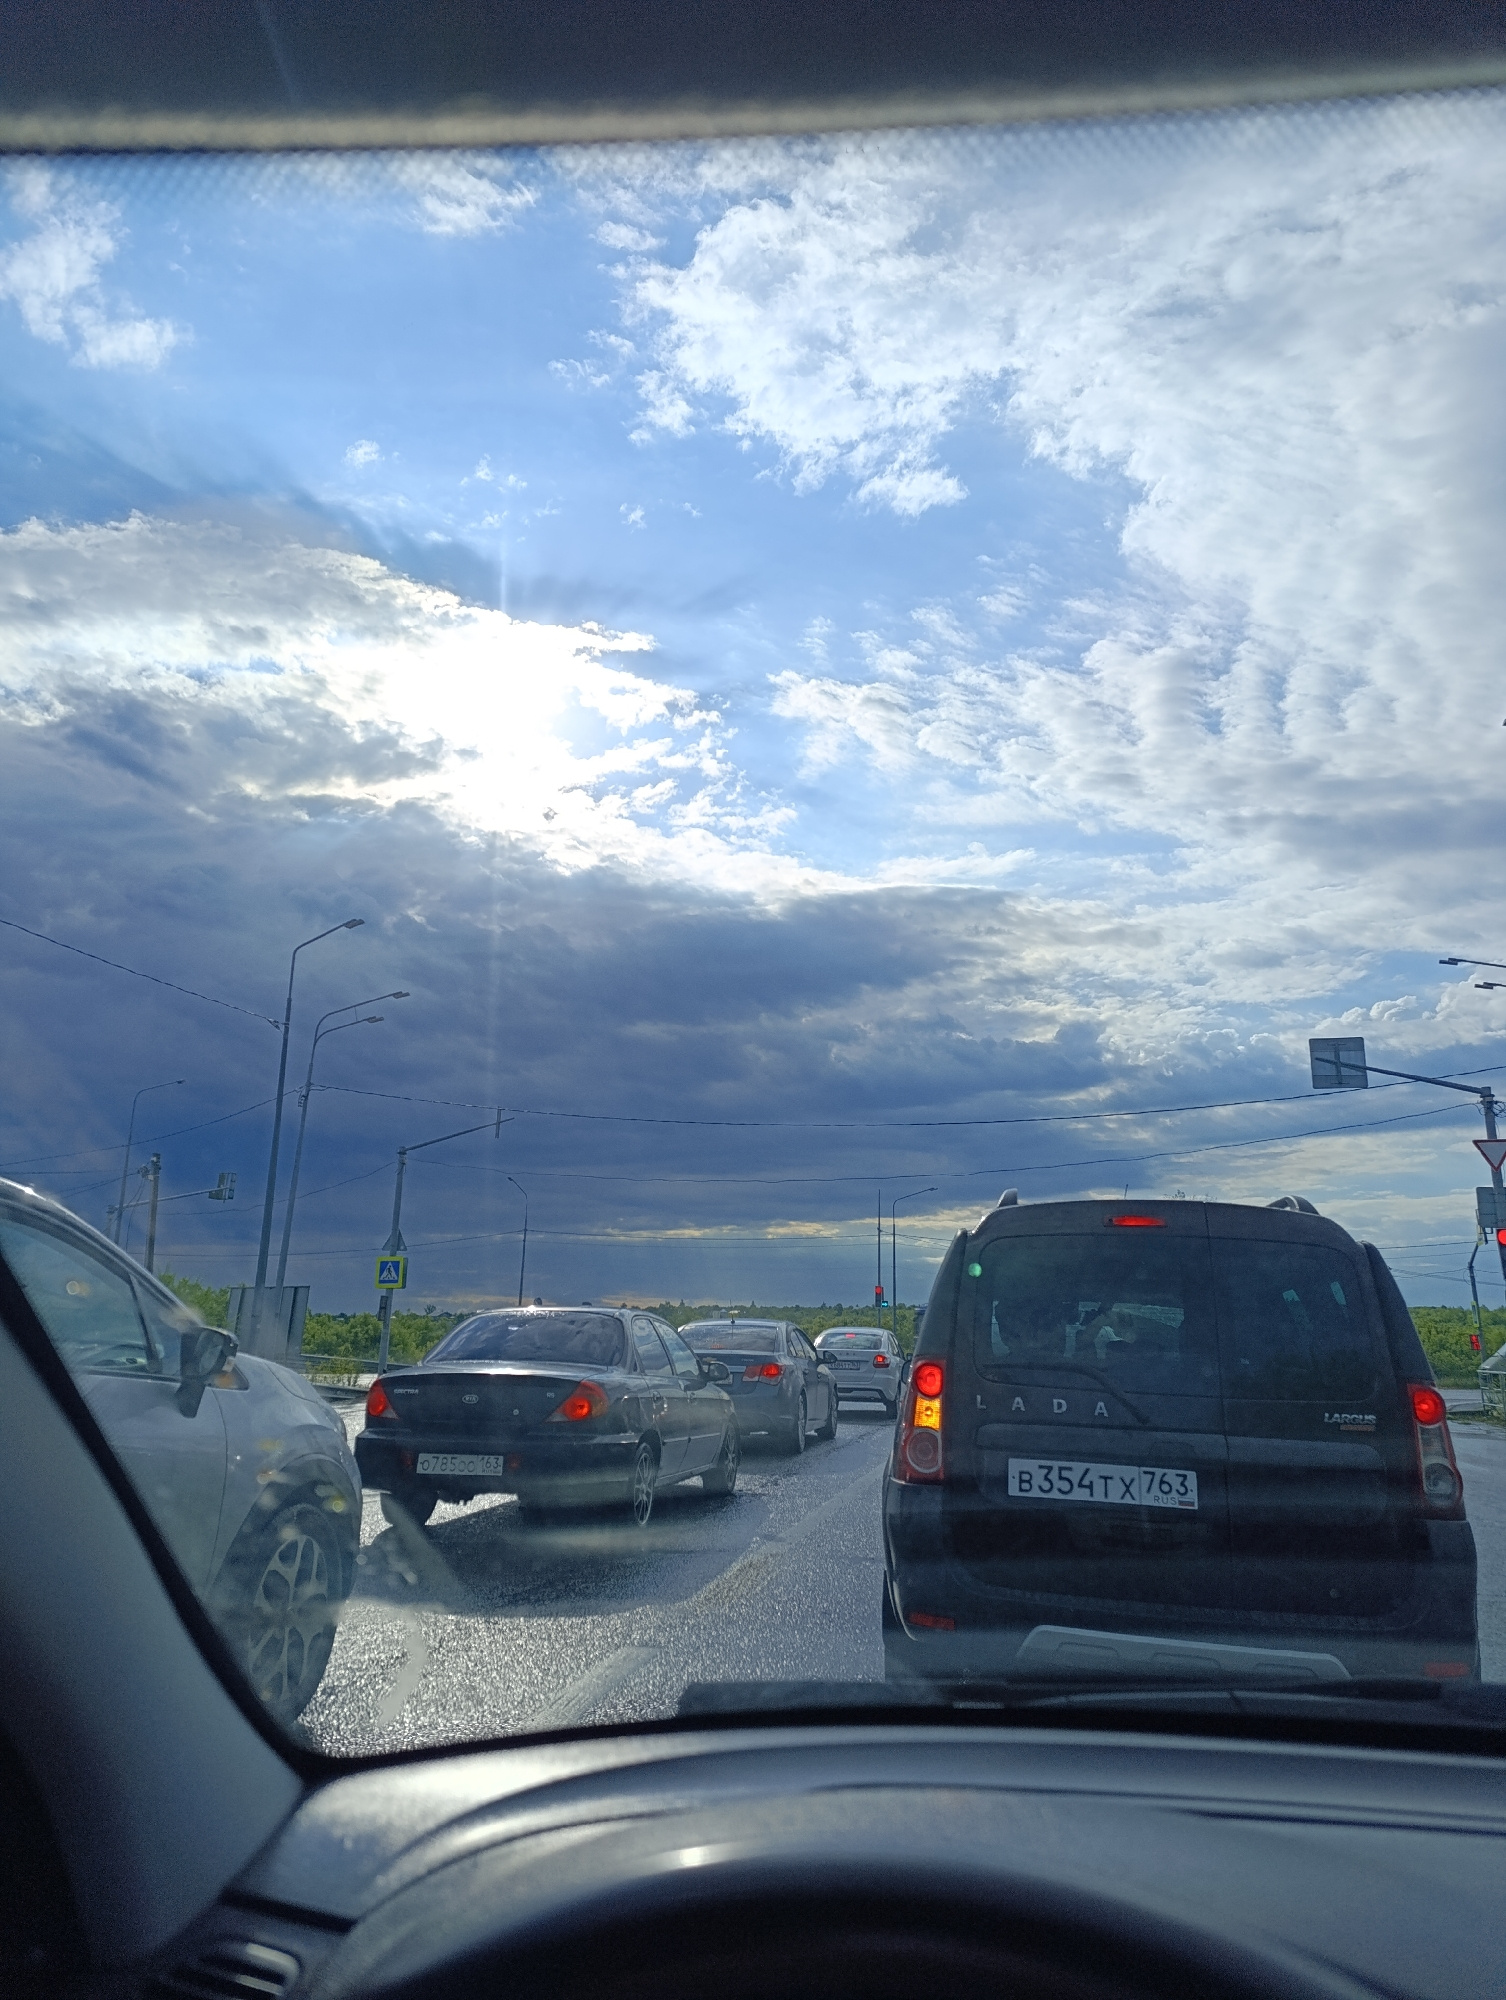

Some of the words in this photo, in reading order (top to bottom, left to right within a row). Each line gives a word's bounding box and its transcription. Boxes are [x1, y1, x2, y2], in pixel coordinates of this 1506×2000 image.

[976, 1394, 1109, 1417] LADA
[1324, 1411, 1377, 1425] LARGUS
[480, 1456, 500, 1470] 163
[1142, 1471, 1189, 1497] 763
[1153, 1496, 1177, 1506] RUS
